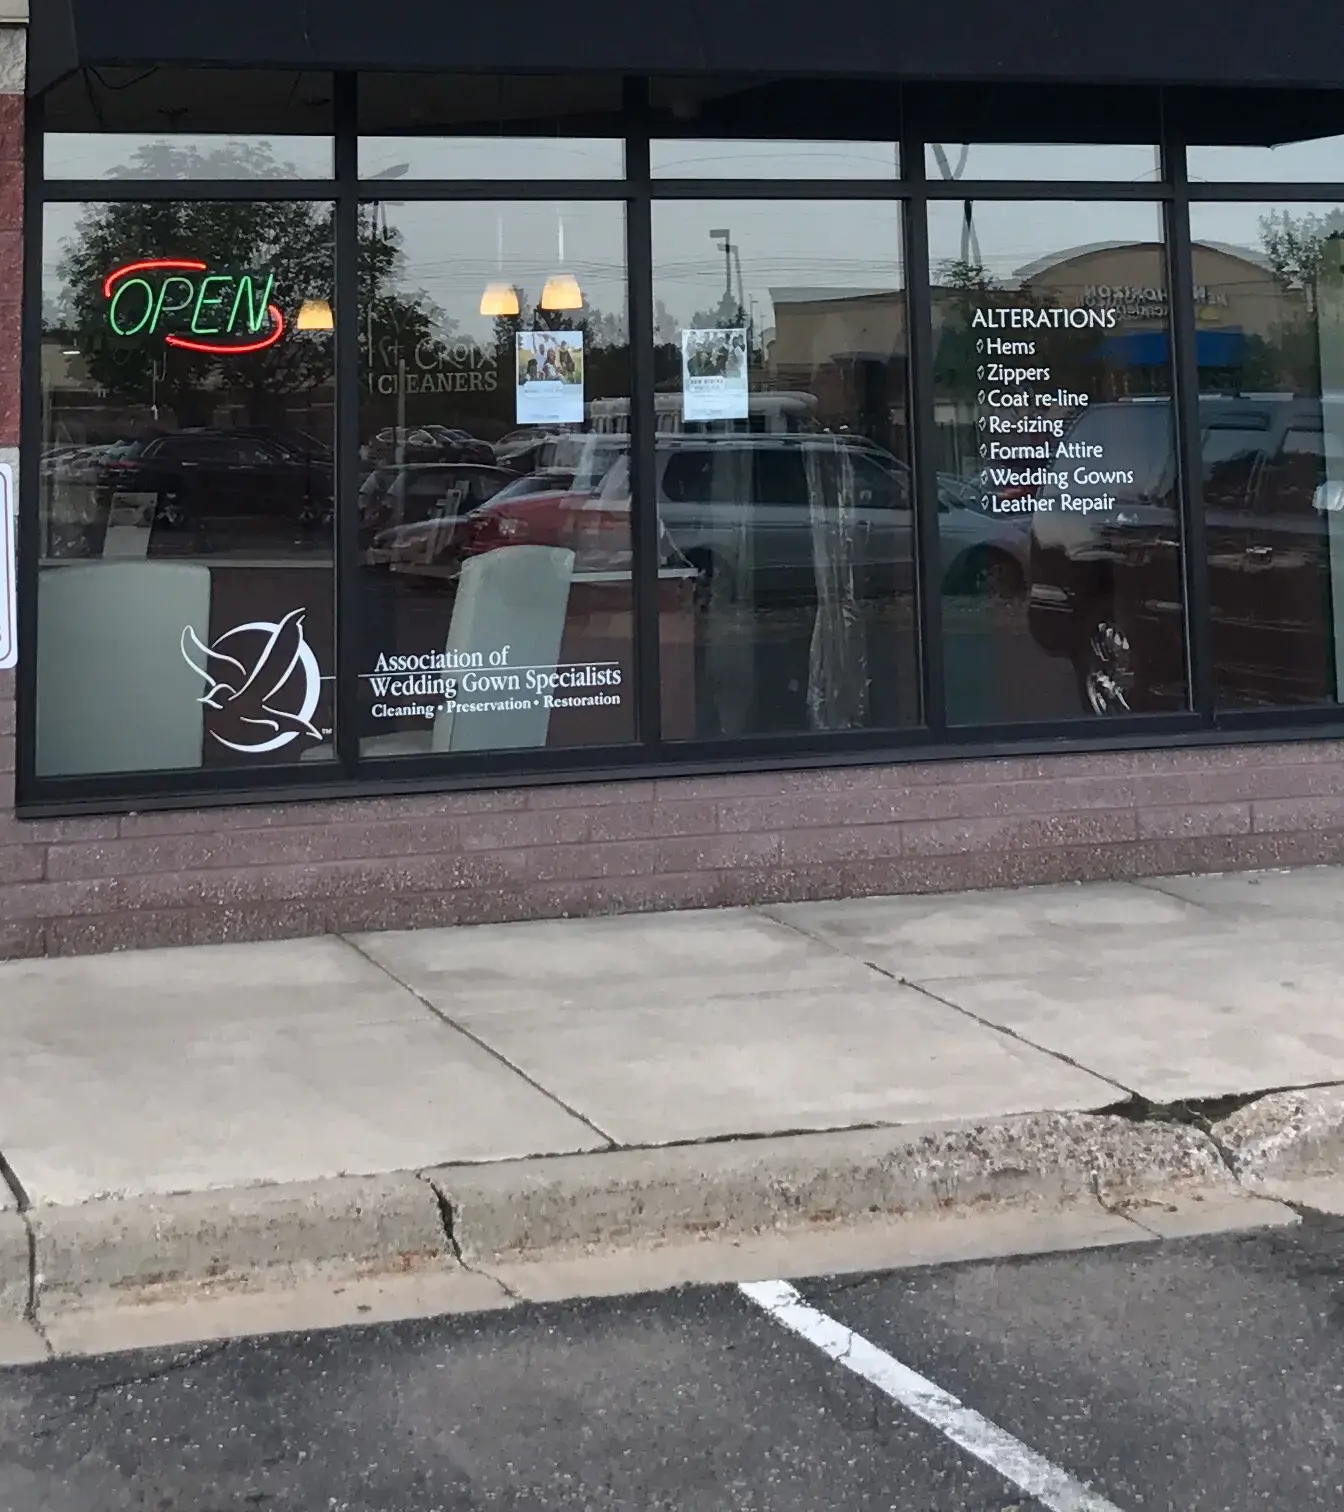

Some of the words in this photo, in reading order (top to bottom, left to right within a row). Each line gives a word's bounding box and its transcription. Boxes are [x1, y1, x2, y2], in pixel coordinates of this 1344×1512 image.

[110, 273, 274, 336] OPEN
[971, 308, 1117, 329] ALTERATIONS
[986, 338, 1036, 355] Hems
[377, 370, 498, 396] CLEANERS
[987, 364, 1051, 385] Zippers
[987, 389, 1030, 407] Coat
[1035, 389, 1089, 407] re-line
[989, 416, 1064, 437] Re-sizing
[990, 442, 1050, 460] Formal
[1055, 441, 1104, 459] Attire
[990, 467, 1069, 489] Wedding
[1073, 467, 1134, 485] Gowns
[992, 494, 1056, 513] Leather
[1061, 493, 1116, 515] Repair
[374, 648, 484, 673] Association
[489, 645, 511, 666] of
[369, 673, 458, 699] Wedding
[462, 671, 521, 693] Gown
[525, 666, 622, 695] Specialists
[371, 703, 435, 719] Cleaning
[446, 697, 532, 714] Preservation
[543, 692, 621, 709] Restoration
